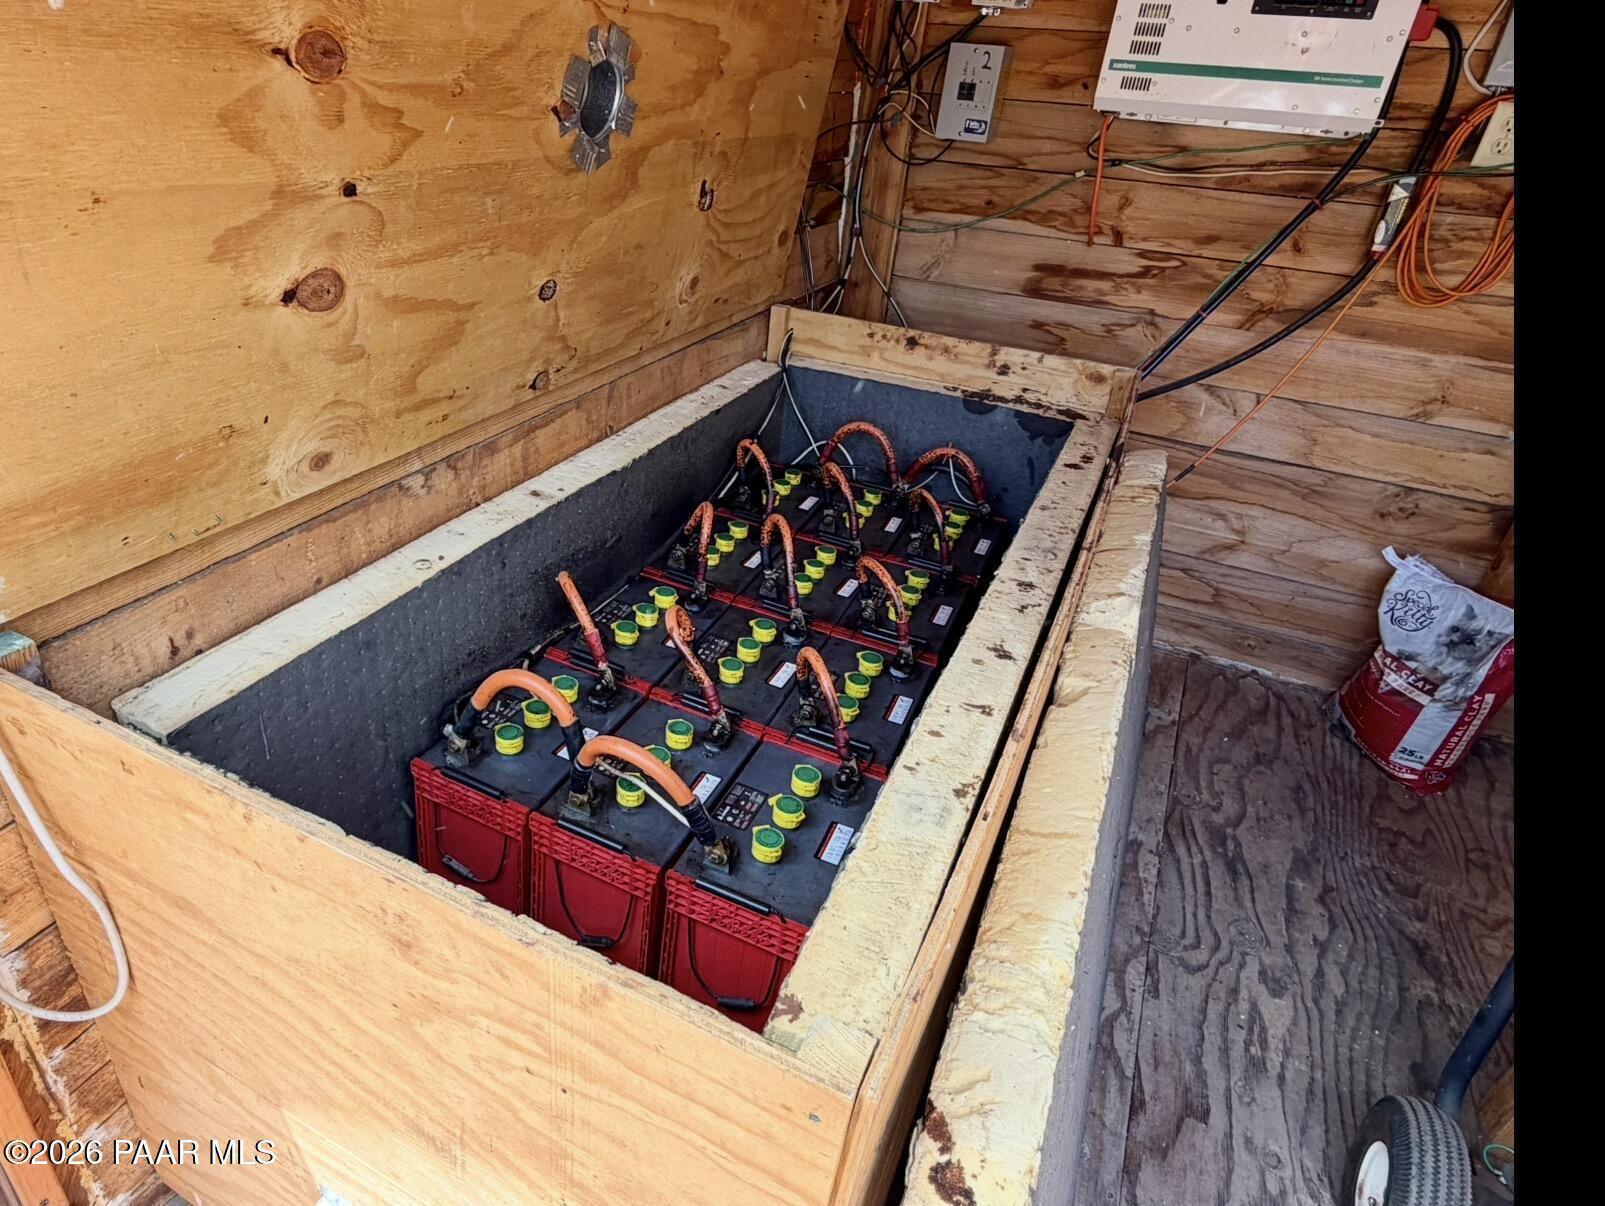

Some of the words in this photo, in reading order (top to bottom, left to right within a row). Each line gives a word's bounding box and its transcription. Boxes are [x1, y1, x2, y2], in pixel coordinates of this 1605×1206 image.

[982, 51, 992, 70] 2
[1394, 589, 1439, 615] Special
[1384, 599, 1437, 632] Kitty
[1401, 670, 1433, 691] CLAY
[1434, 725, 1468, 766] NATURAL
[1464, 695, 1483, 721] CLAY
